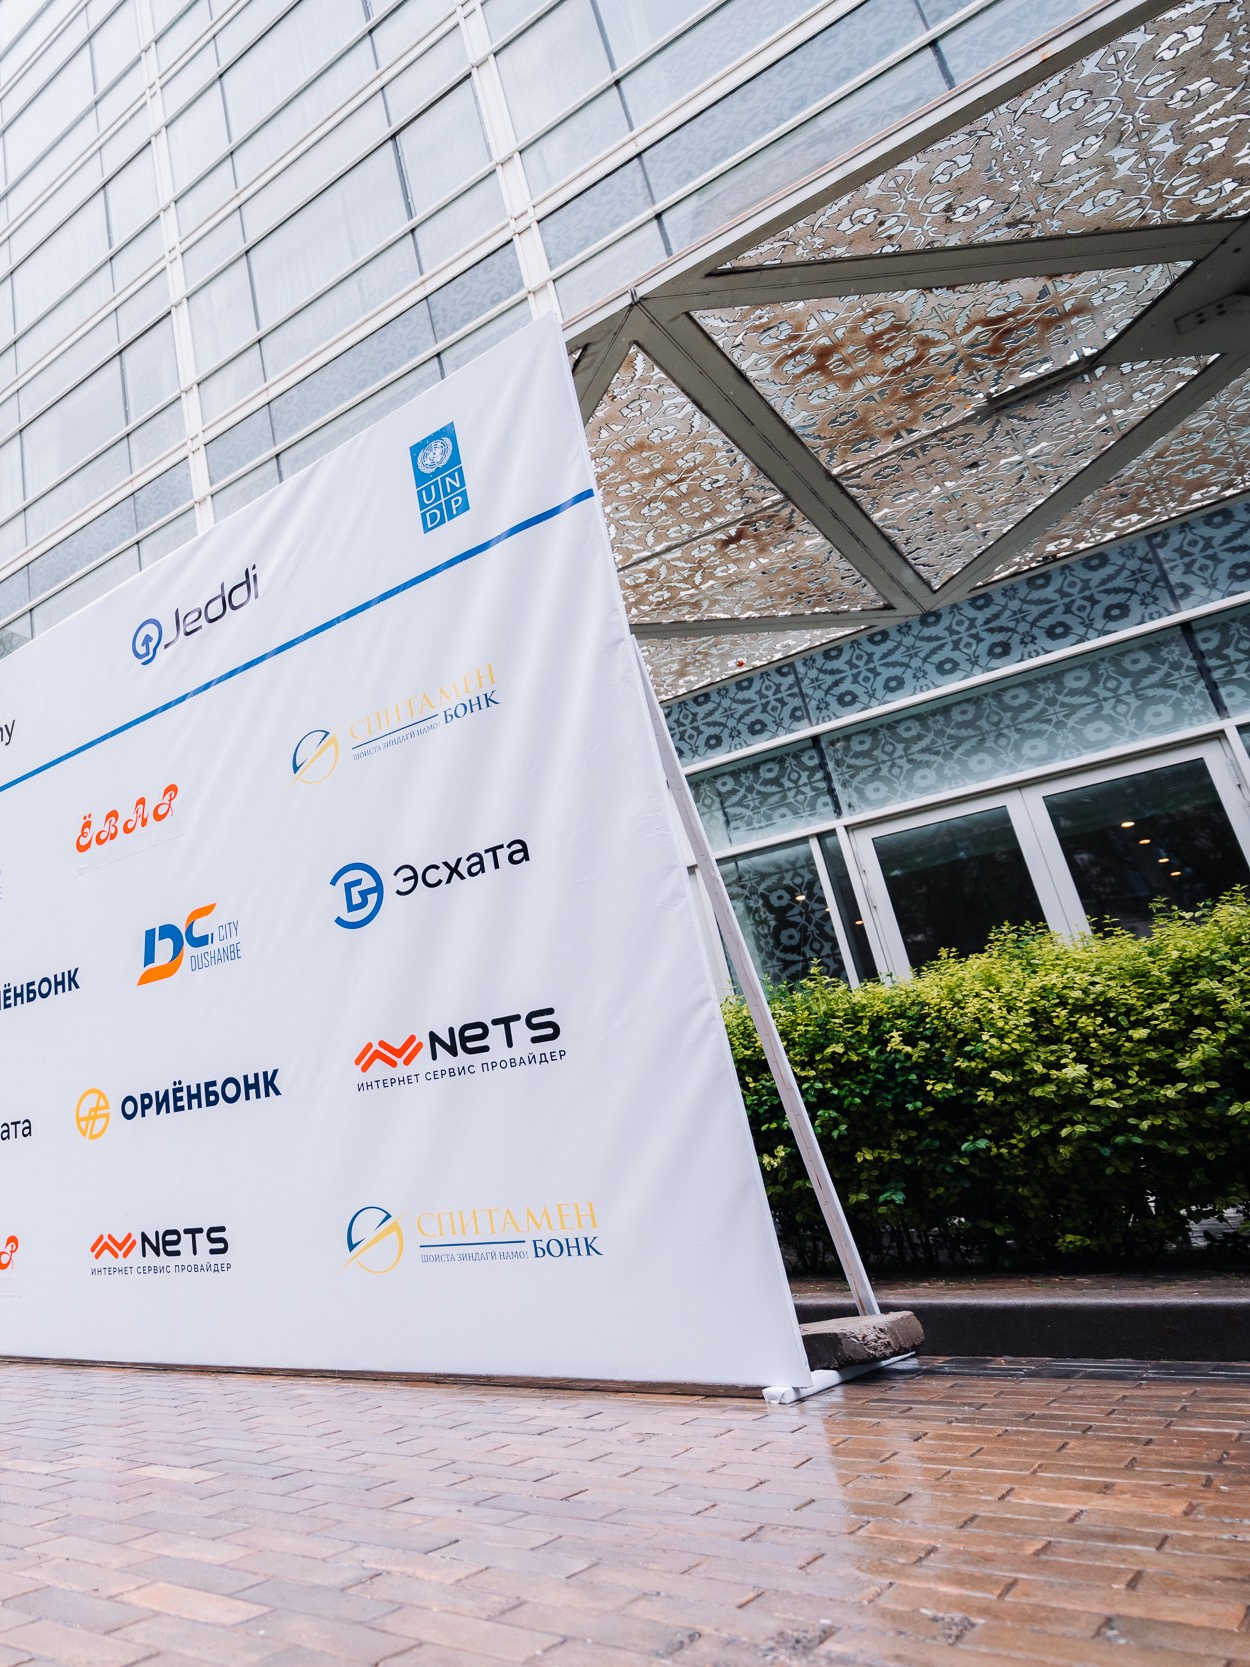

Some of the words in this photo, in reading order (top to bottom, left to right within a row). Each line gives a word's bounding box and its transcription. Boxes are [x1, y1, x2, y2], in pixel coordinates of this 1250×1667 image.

[163, 563, 260, 650] Jeddi
[349, 663, 496, 741] СПИТАМЕН
[442, 689, 502, 725] БОНК
[392, 838, 531, 896] Эсхата
[218, 920, 239, 942] CITY
[190, 942, 242, 972] DUSHANBE
[357, 1073, 421, 1092] ИНТЕРНЕТ
[424, 1064, 477, 1082] СЕРВИС
[481, 1049, 568, 1073] ПРОВАЙДЕР
[120, 1068, 282, 1121] ОРИЁНБОНК
[416, 1201, 598, 1238] СПИТАМЕН
[498, 1250, 529, 1260] НАМО!
[531, 1236, 604, 1259] БОНК
[90, 1266, 134, 1276] ИНТЕРНЕТ
[136, 1265, 171, 1275] СЕРВИС
[174, 1261, 232, 1274] ПРОВАЙДЕР
